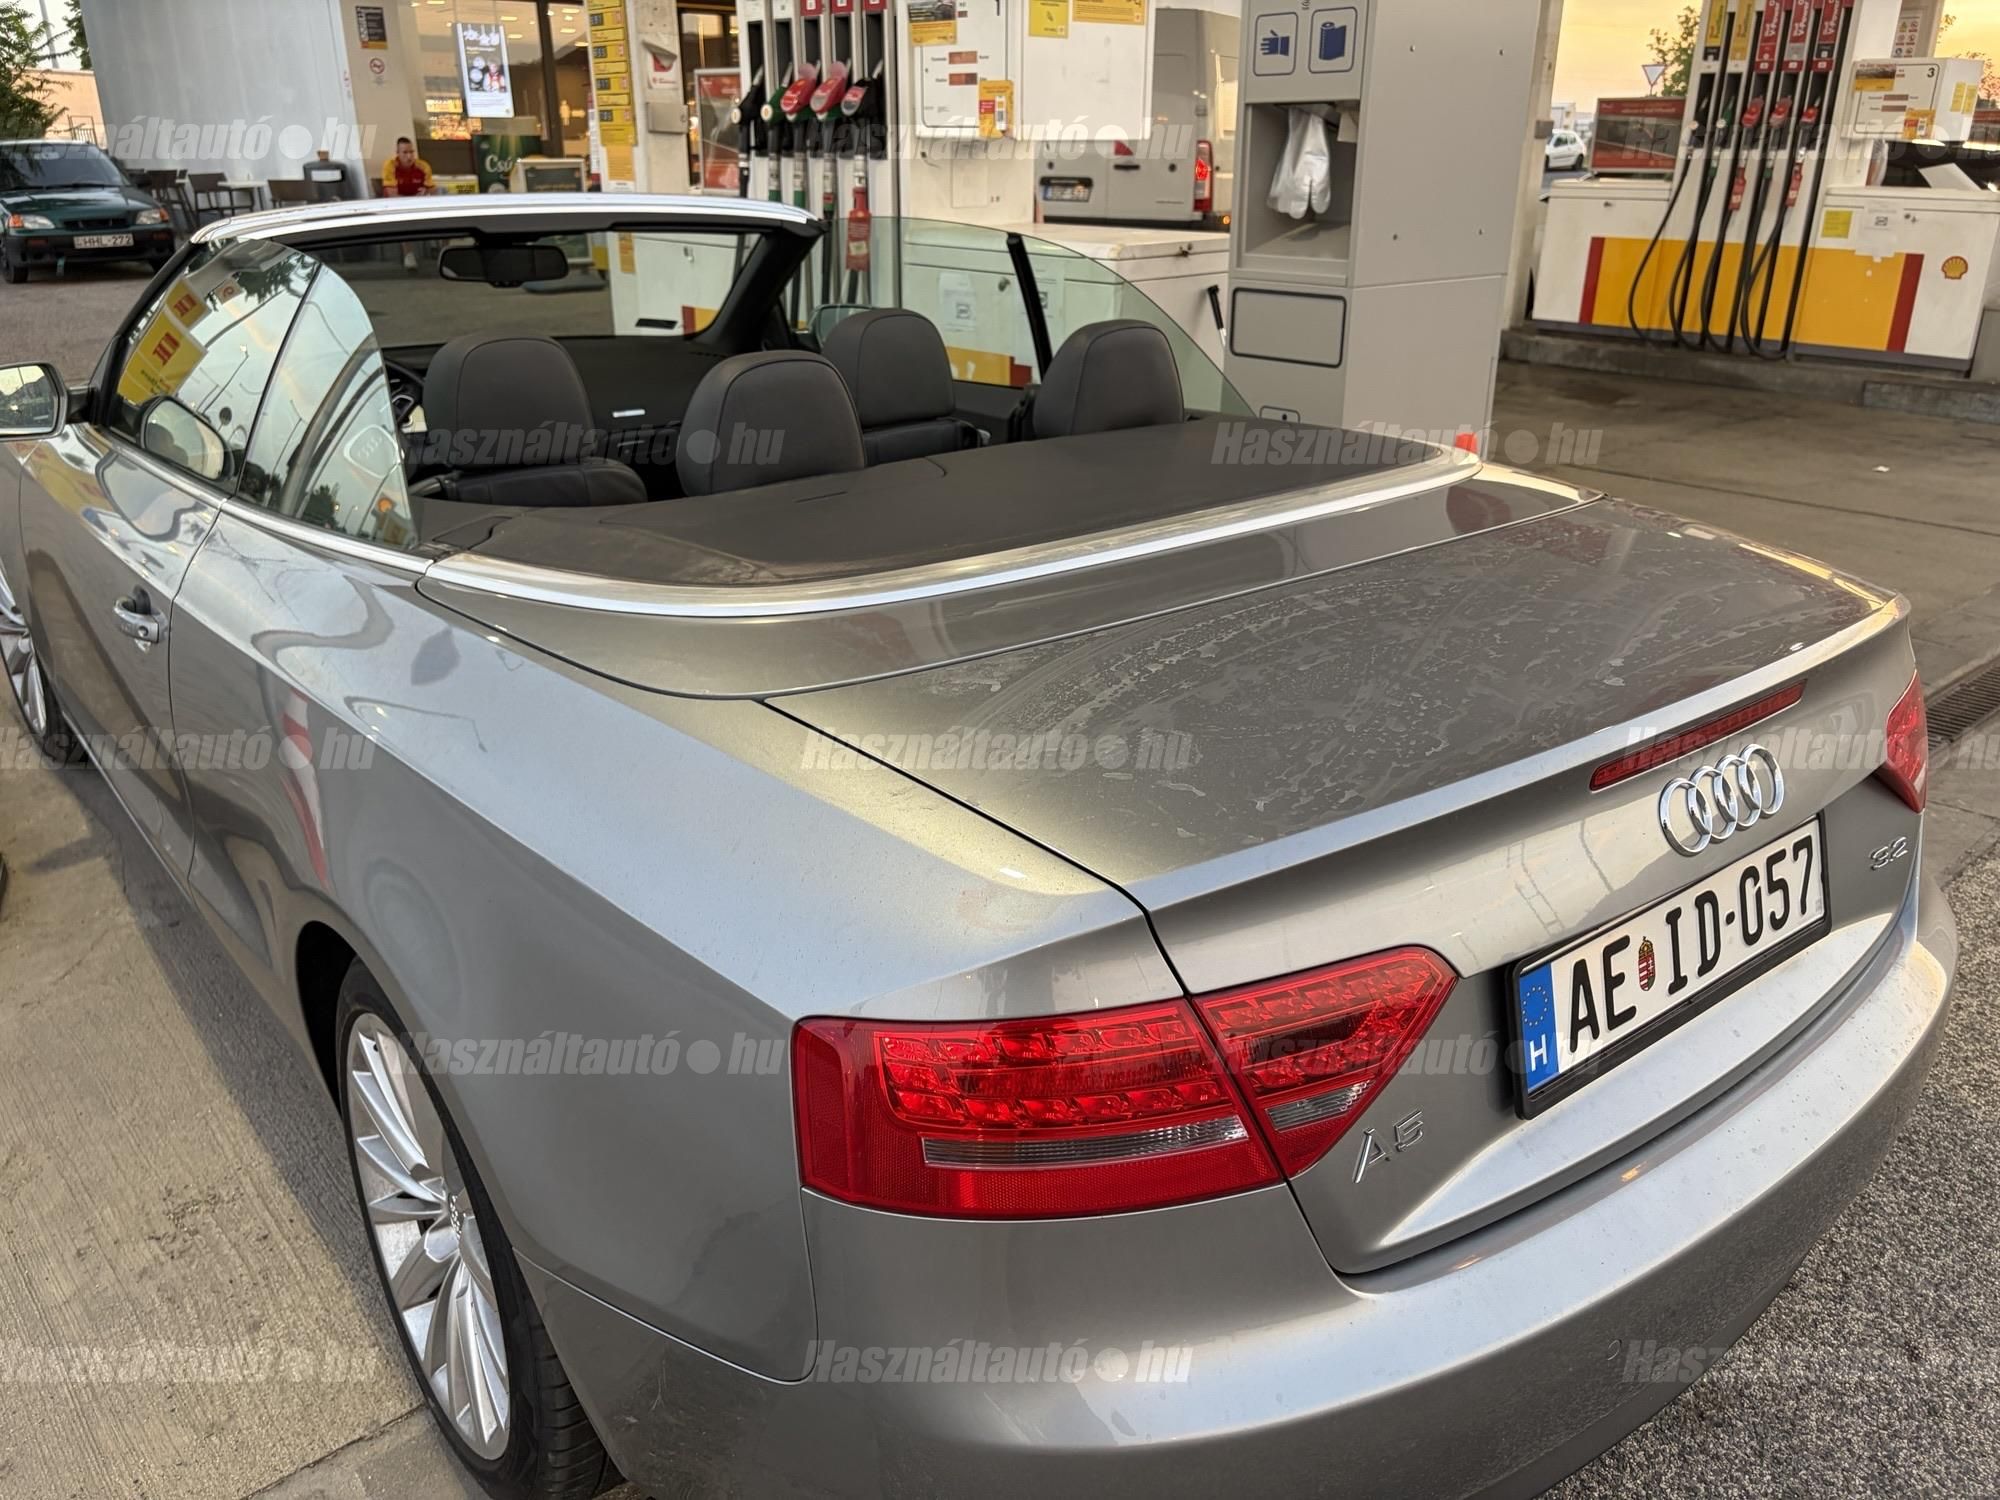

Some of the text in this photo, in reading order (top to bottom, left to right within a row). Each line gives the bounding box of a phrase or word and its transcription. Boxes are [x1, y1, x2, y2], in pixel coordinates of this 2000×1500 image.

[1926, 67, 1936, 78] 3
[1869, 836, 1908, 871] 3.2
[1569, 934, 1637, 1053] AE
[1529, 1033, 1548, 1072] H
[1352, 1107, 1424, 1184] A5
